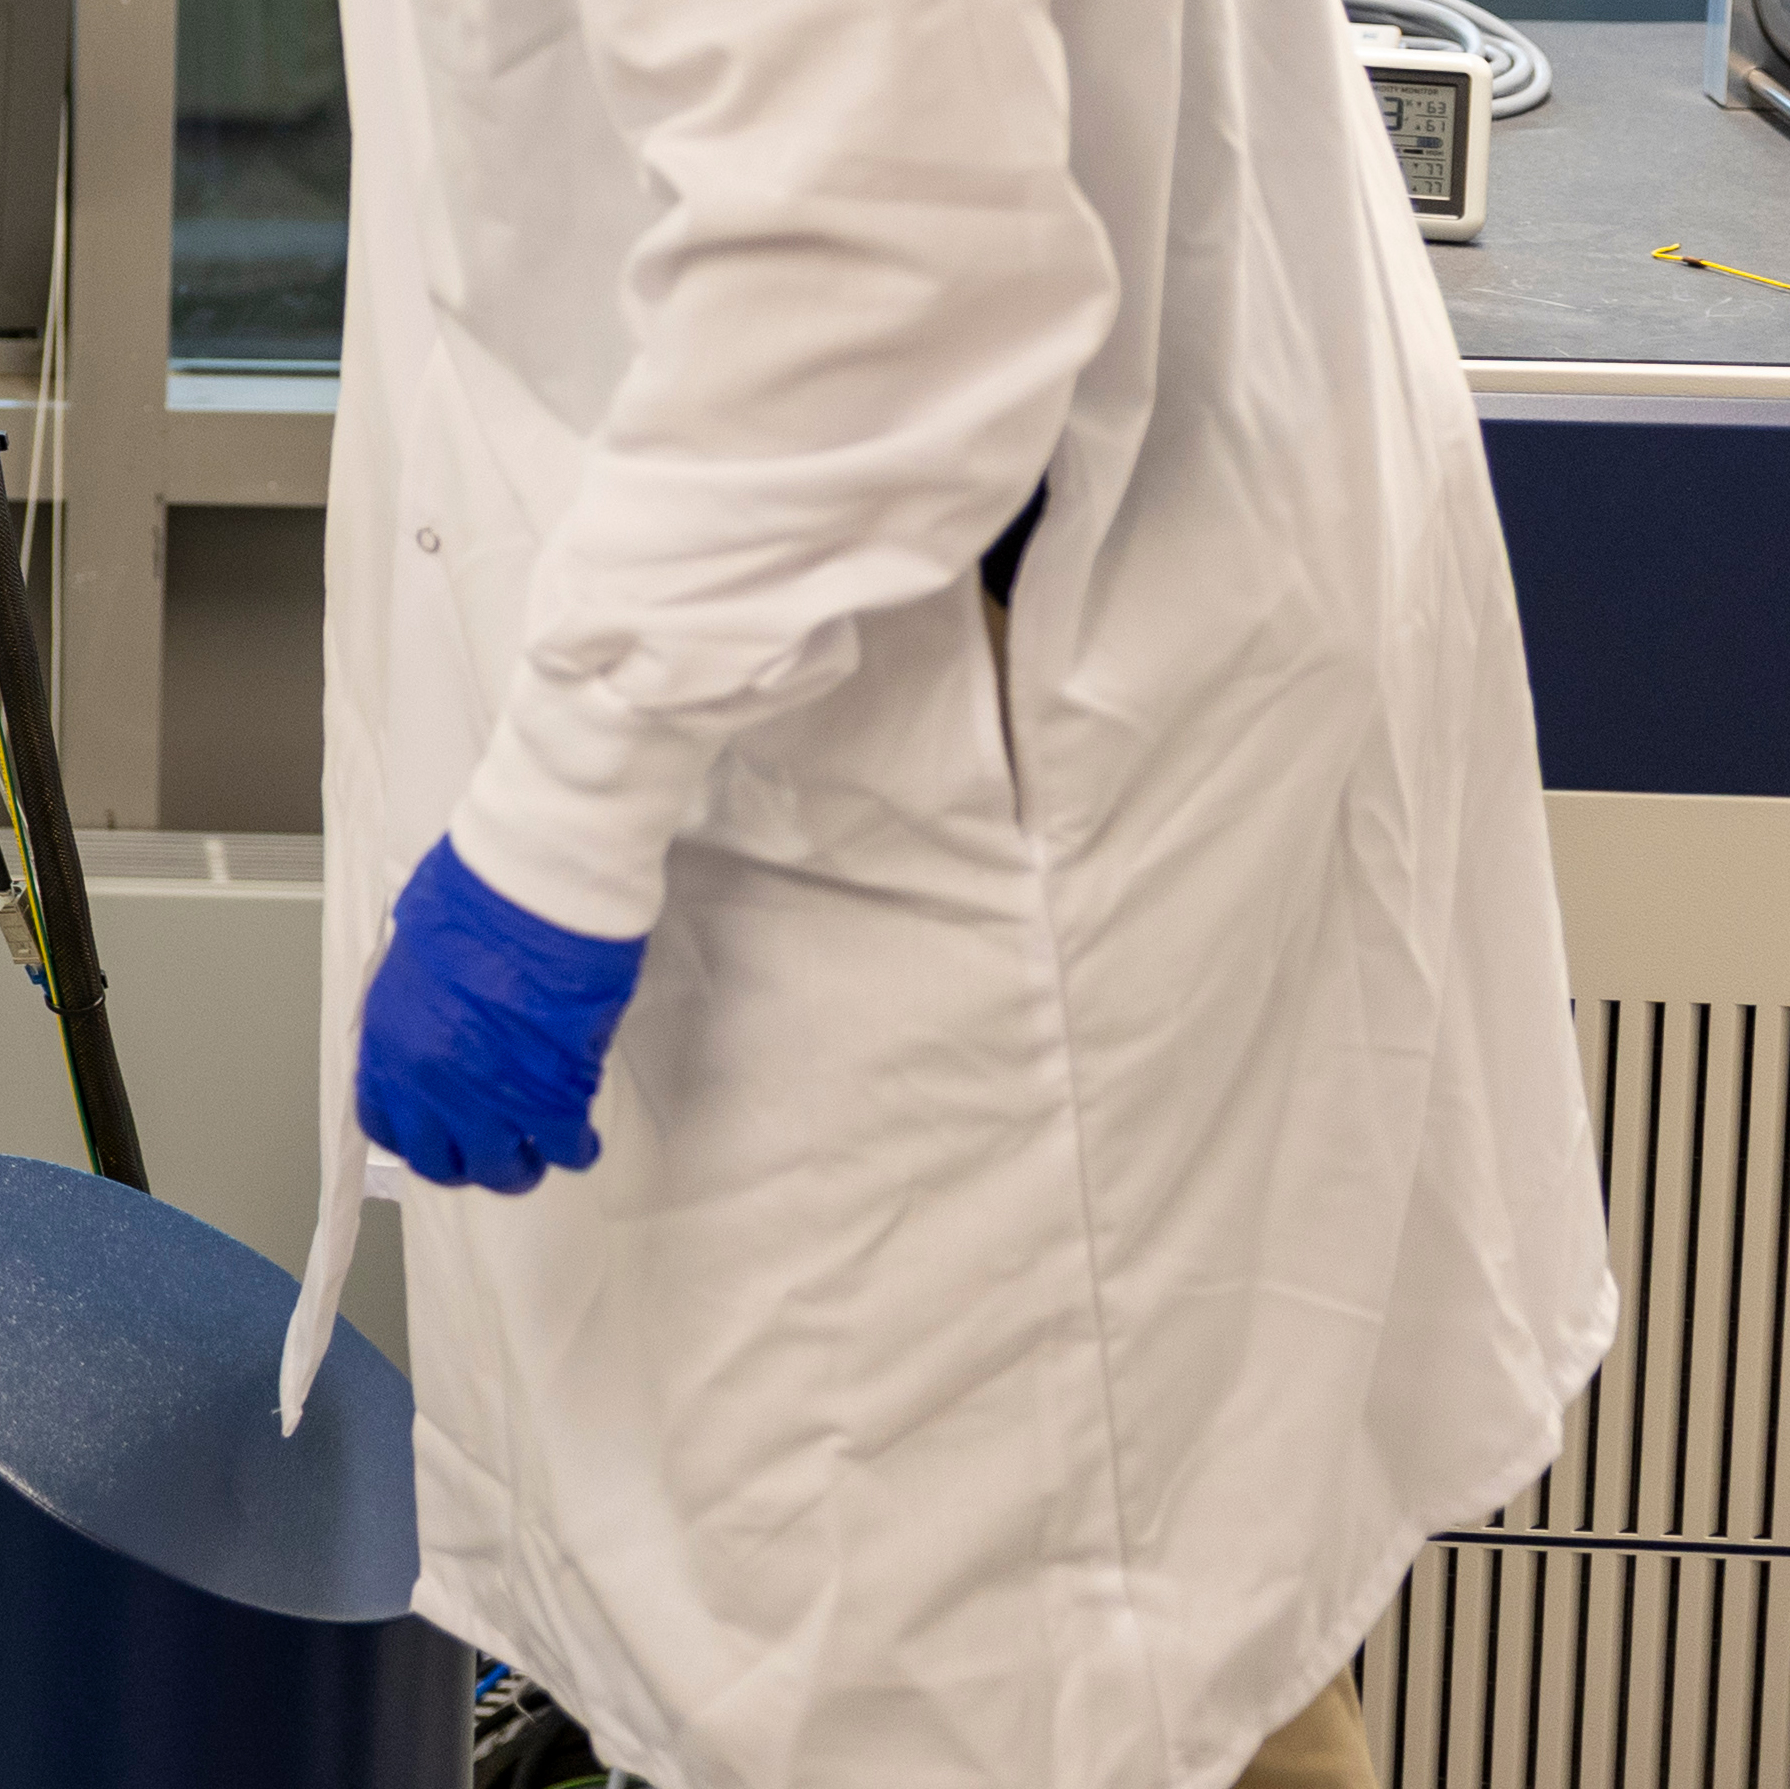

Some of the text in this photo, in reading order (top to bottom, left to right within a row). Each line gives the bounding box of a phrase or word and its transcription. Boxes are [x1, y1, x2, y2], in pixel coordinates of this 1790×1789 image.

[1401, 87, 1439, 96] MONITOR
[1427, 101, 1447, 115] 63
[1426, 119, 1446, 132] 61
